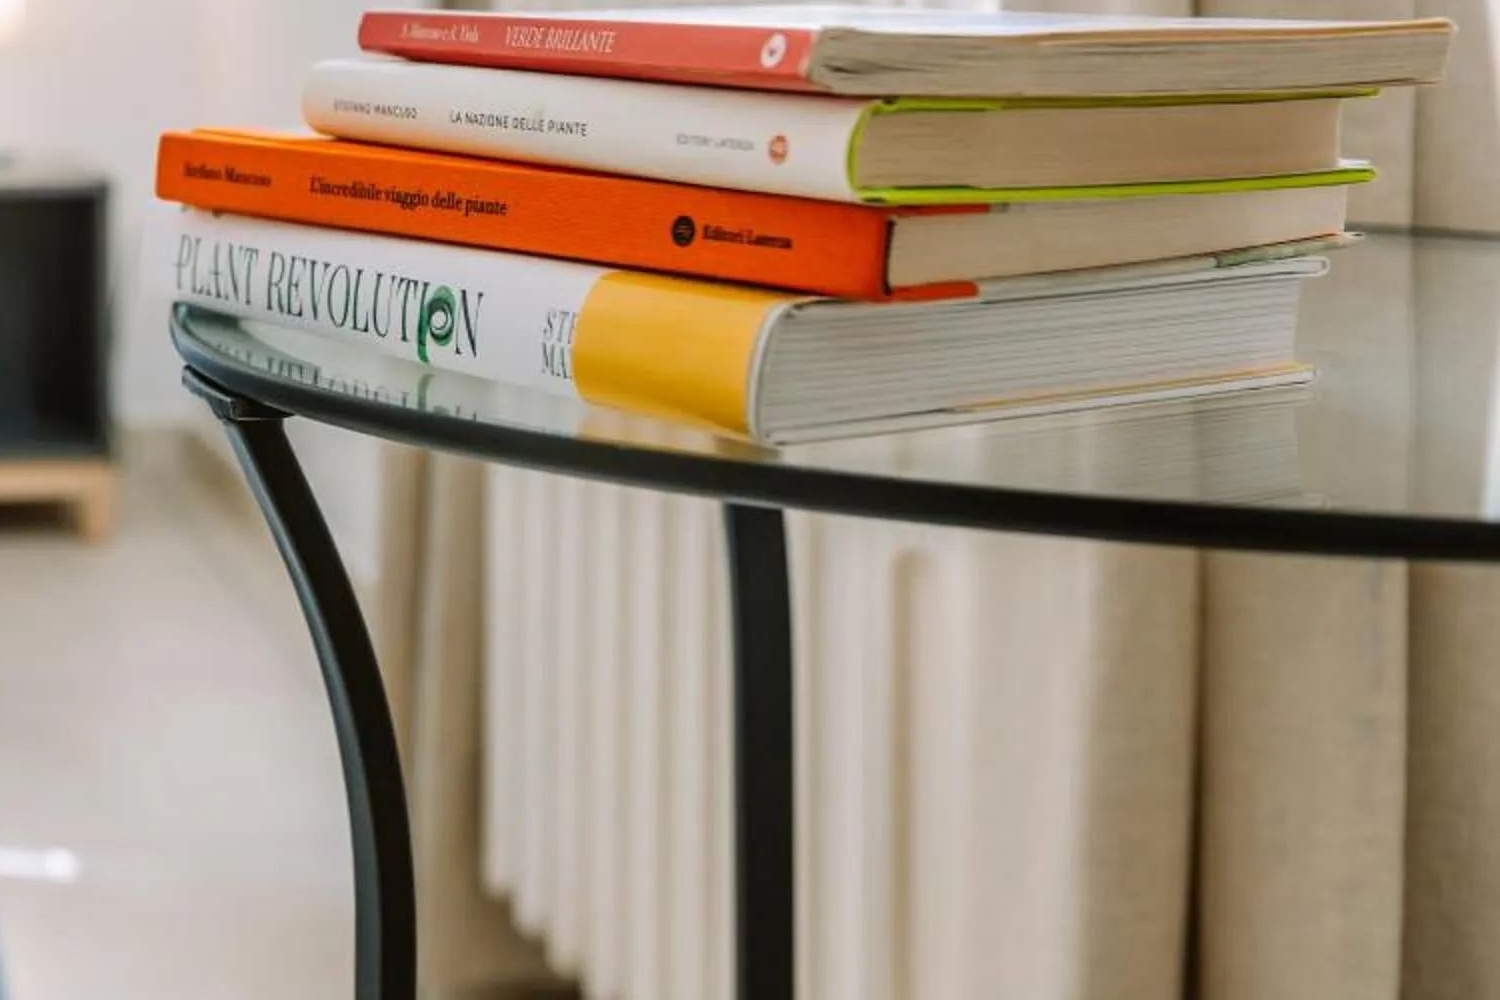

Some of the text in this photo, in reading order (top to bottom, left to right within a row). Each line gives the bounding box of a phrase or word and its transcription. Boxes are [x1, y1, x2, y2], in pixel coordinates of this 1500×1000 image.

[505, 24, 617, 53] VERDE BRILLANTE
[333, 97, 418, 120] STEFANO MANCUSO
[450, 109, 589, 137] LA NAZIONE DELLE PIANTE
[310, 175, 508, 217] L'incredibile viaggio delle piante
[171, 232, 259, 306] PLANT
